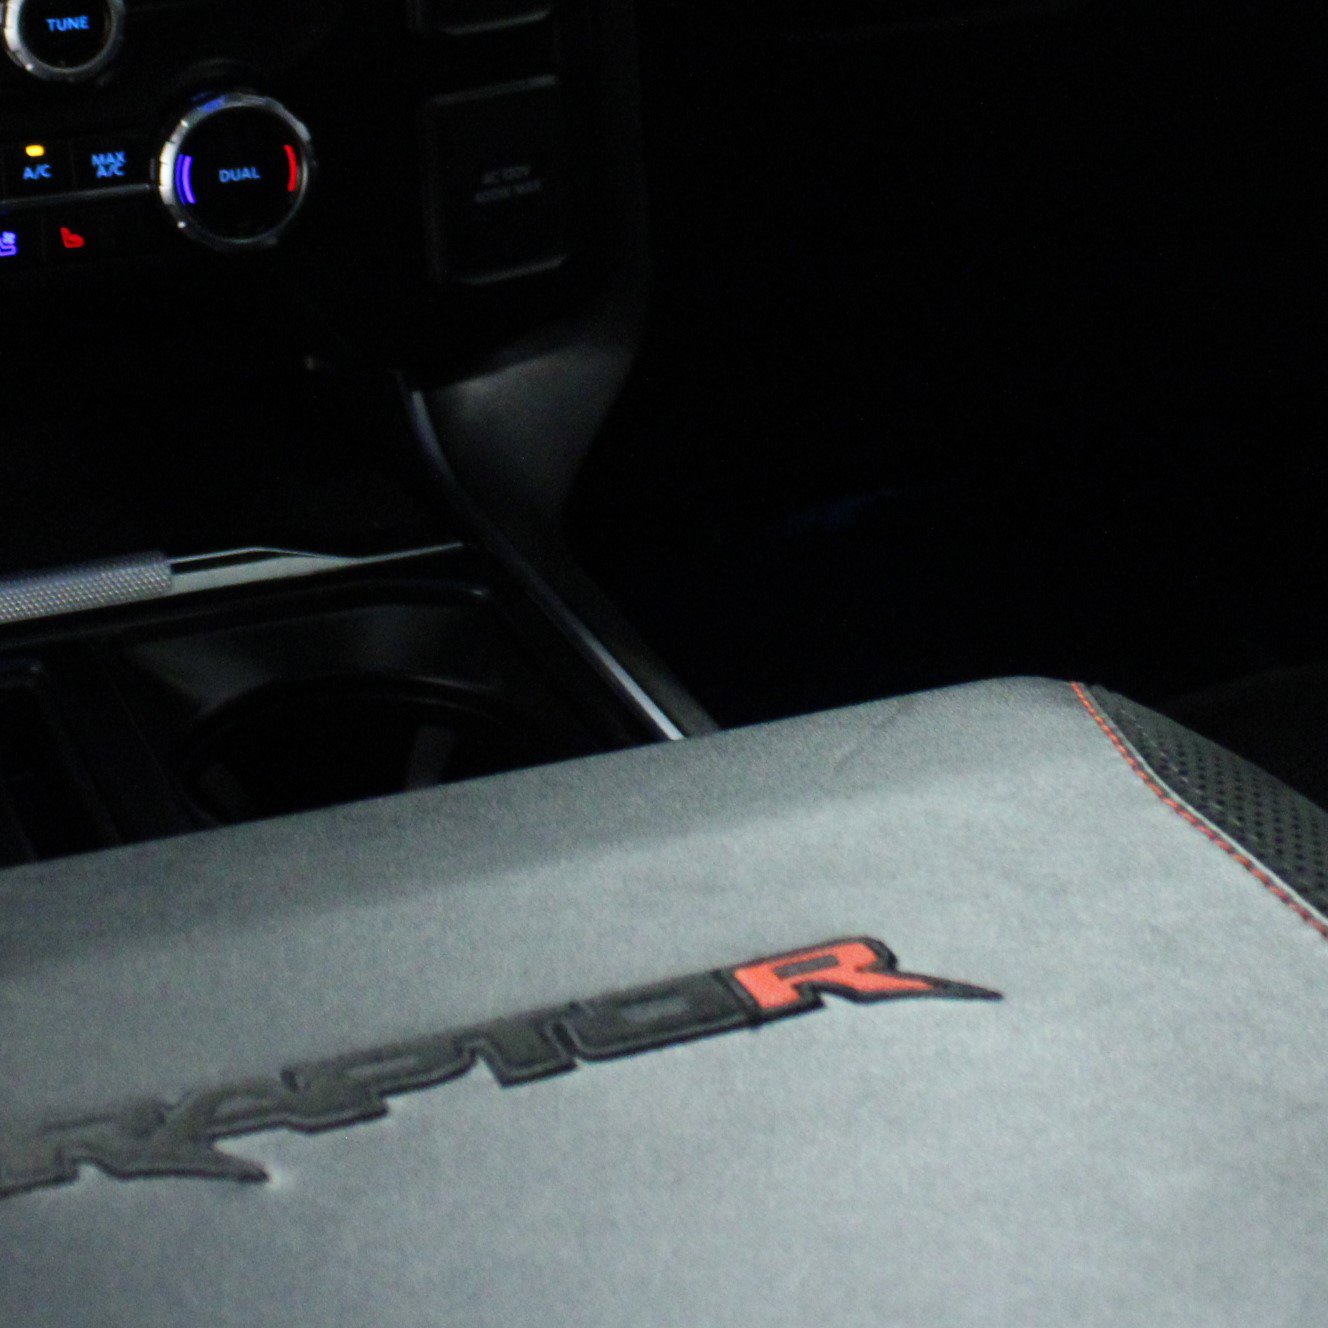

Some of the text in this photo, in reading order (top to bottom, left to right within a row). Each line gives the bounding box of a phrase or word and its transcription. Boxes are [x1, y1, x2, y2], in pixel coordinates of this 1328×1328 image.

[45, 14, 90, 32] TUNE
[91, 150, 127, 167] MAX
[23, 164, 52, 181] A/C
[96, 163, 126, 179] A/C
[218, 166, 260, 183] DUAL
